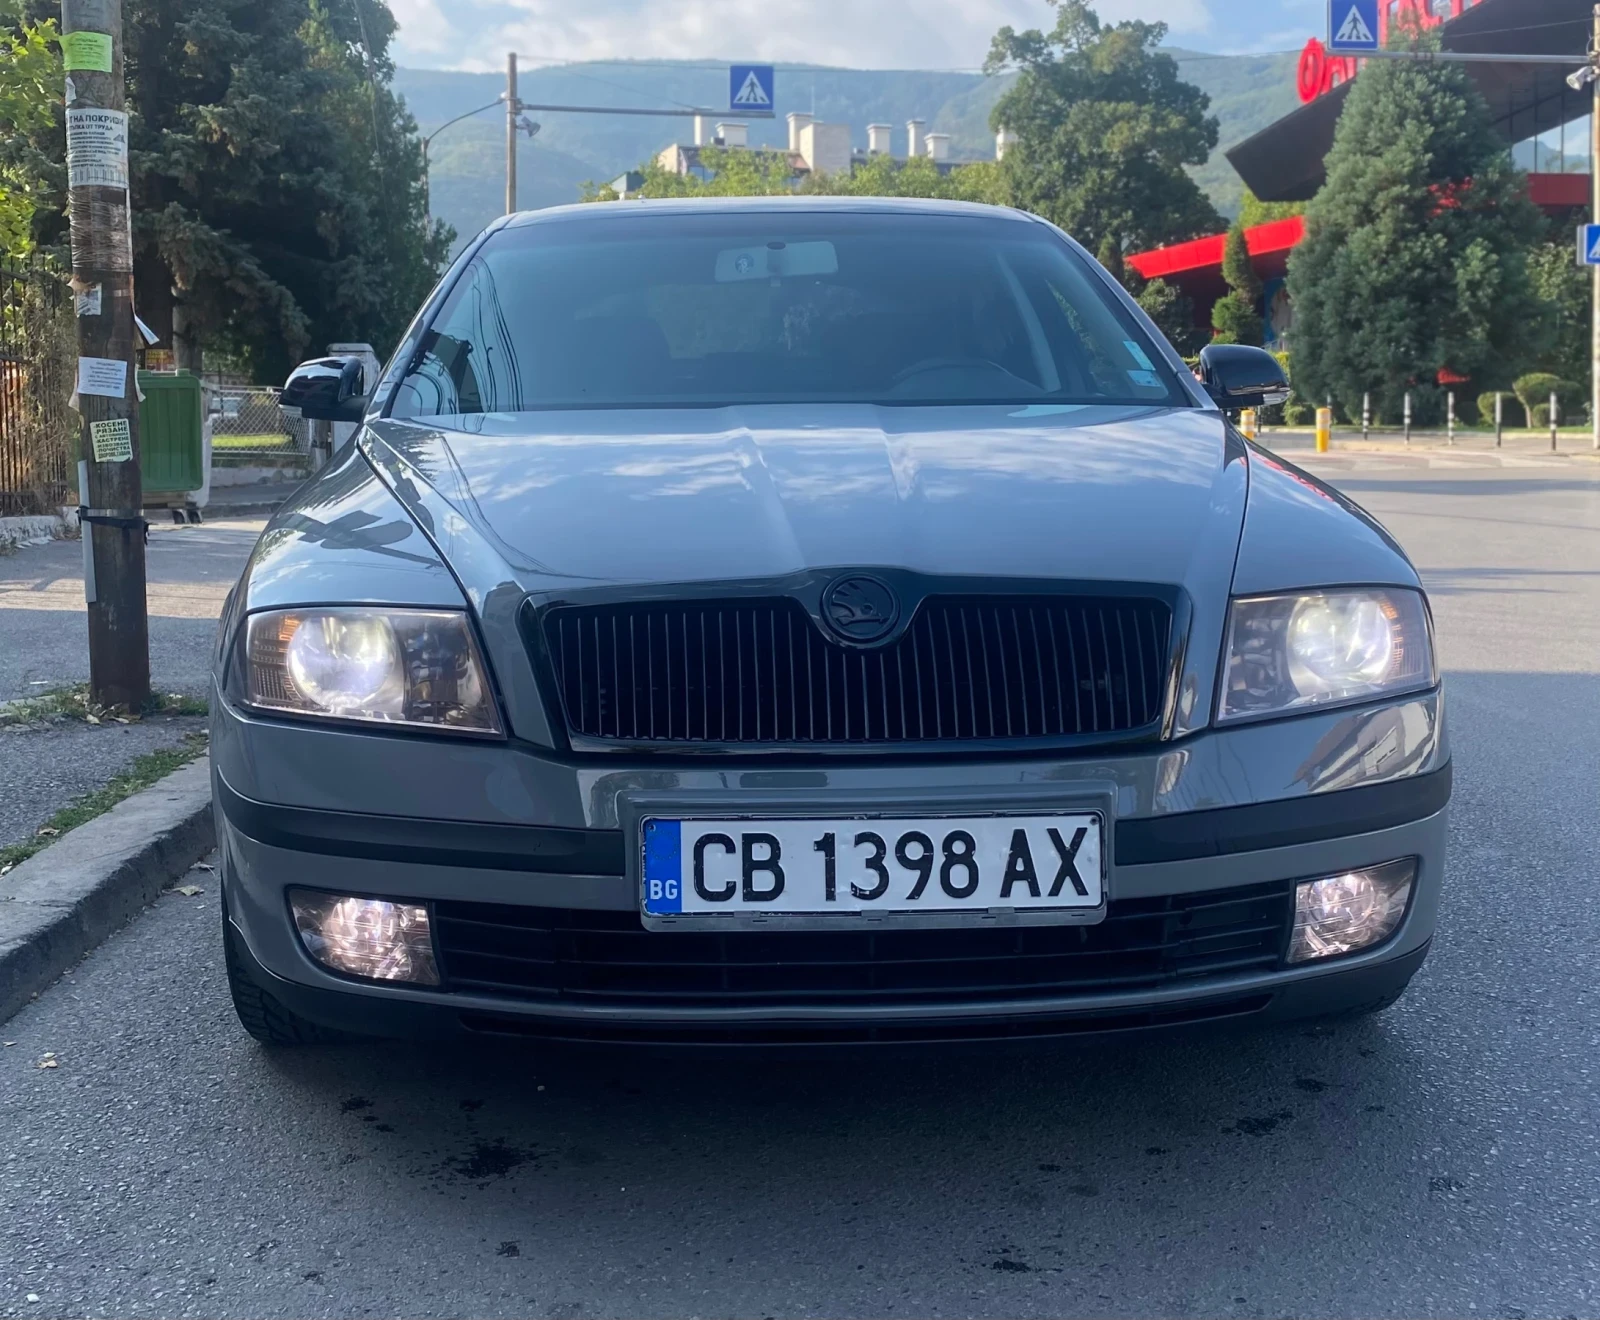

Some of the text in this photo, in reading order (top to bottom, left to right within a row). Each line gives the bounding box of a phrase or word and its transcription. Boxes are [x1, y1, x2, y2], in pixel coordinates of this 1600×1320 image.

[693, 827, 1089, 902] CB 1398 AX
[650, 879, 678, 900] BG
